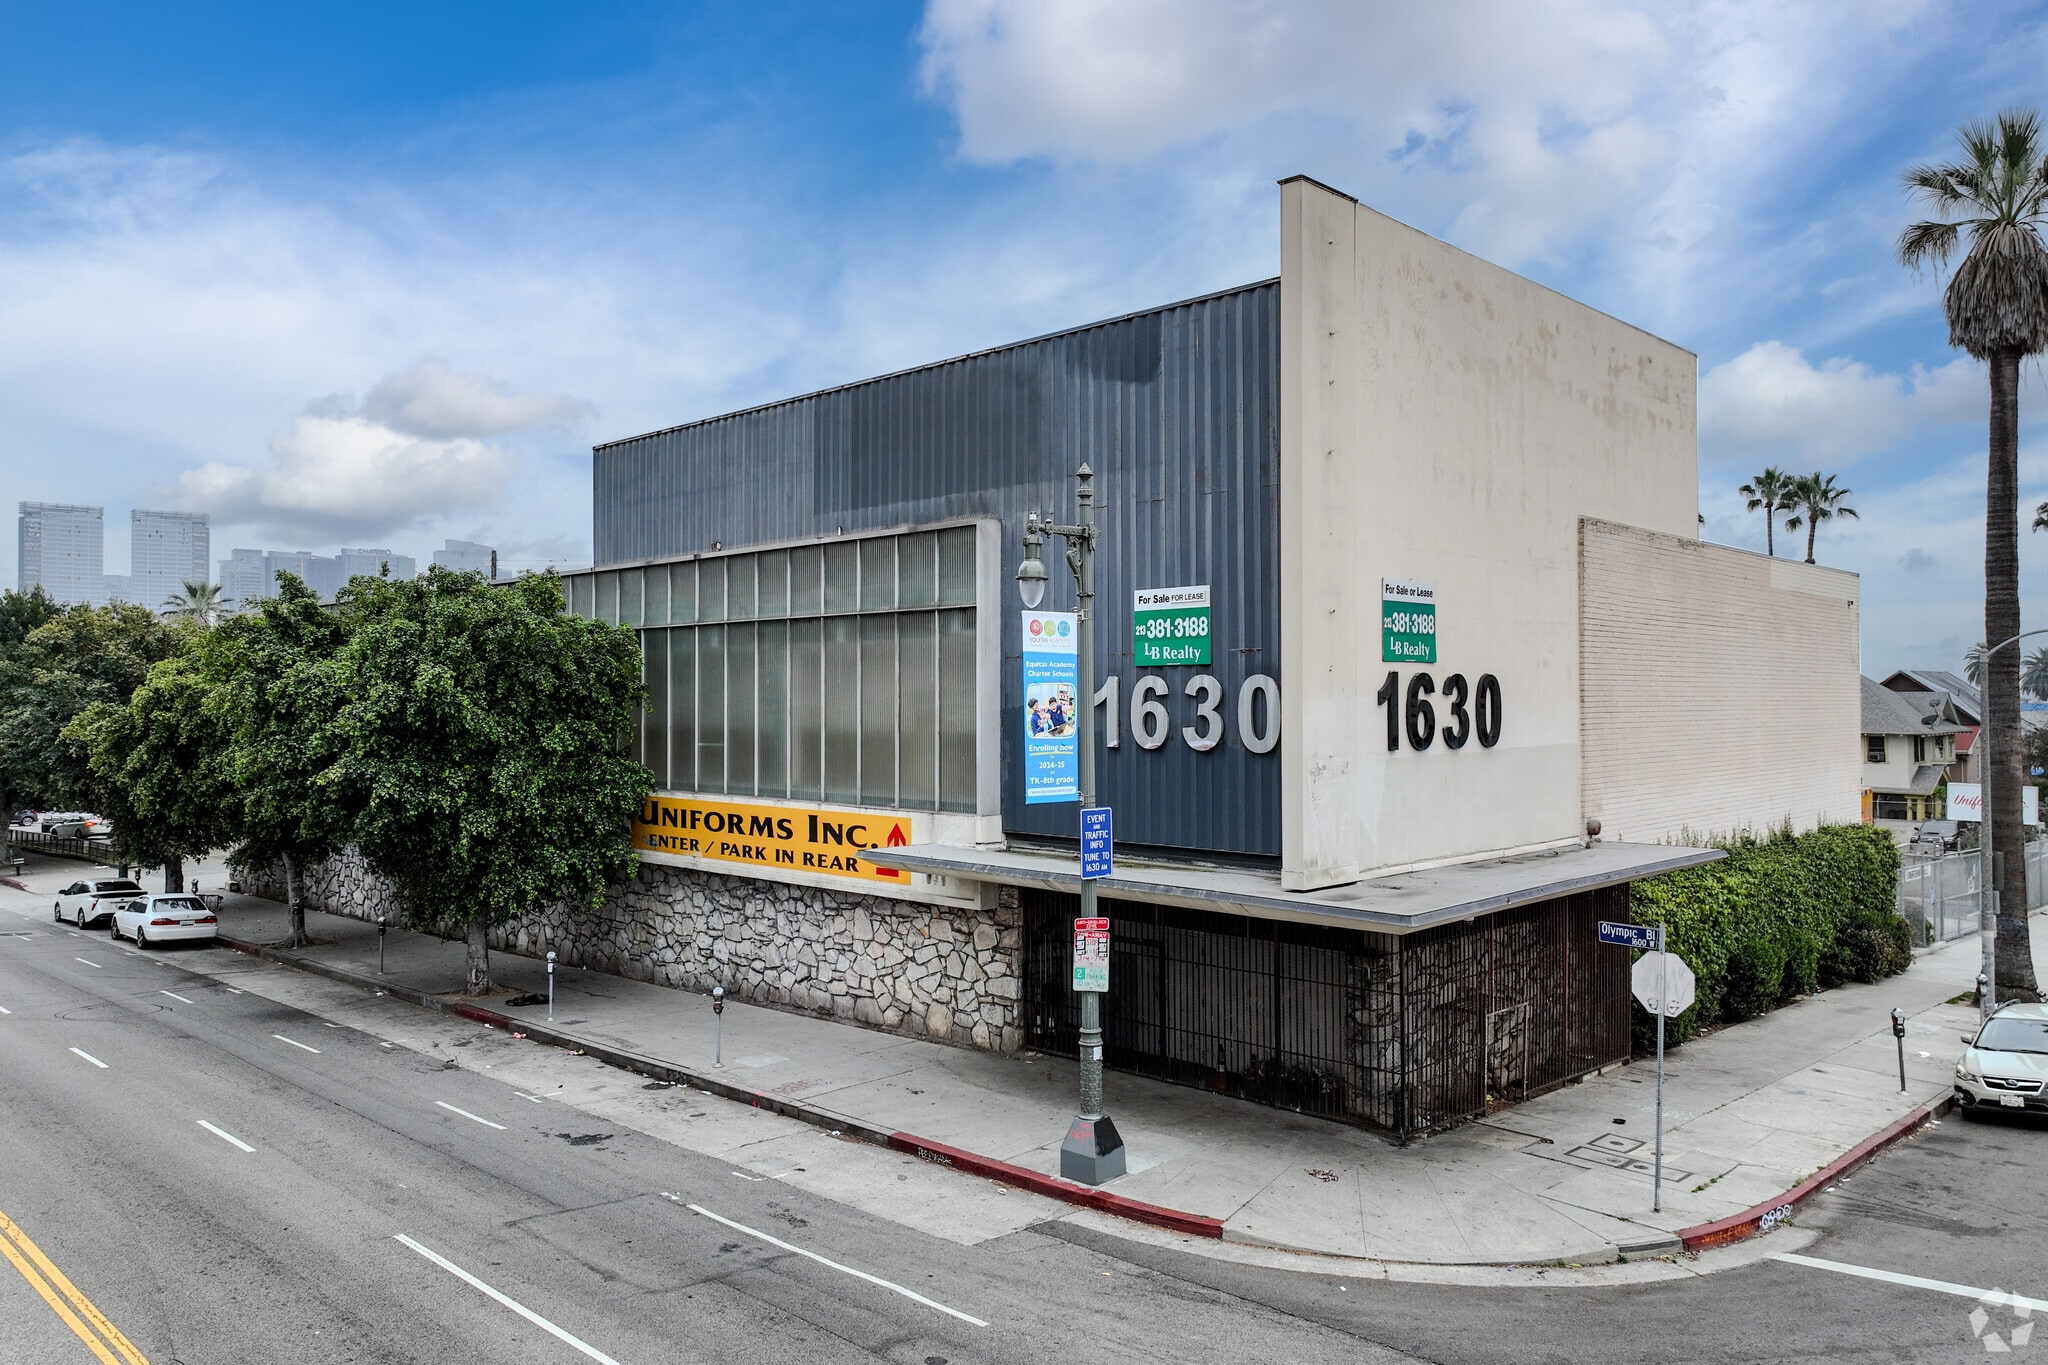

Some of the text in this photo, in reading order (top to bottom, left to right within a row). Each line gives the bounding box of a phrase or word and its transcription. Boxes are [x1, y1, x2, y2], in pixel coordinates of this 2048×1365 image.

[1385, 584, 1433, 598] For Sale or Lease
[1138, 595, 1151, 605] For
[1153, 594, 1170, 604] Sale
[1185, 593, 1203, 601] LEASE
[1135, 625, 1146, 635] 213
[1144, 643, 1201, 662] LB Realty
[1391, 636, 1430, 660] LB Realty
[1094, 674, 1281, 754] 1630
[1378, 671, 1501, 751] 1630
[1029, 744, 1058, 752] Enrolling
[1056, 776, 1074, 785] grade
[639, 800, 793, 840] UNIFORMS
[1087, 814, 1106, 823] EVENT
[1085, 830, 1108, 840] TRAFFIC
[1090, 840, 1103, 849] INFO
[648, 833, 700, 851] ENTER
[721, 842, 766, 861] PARK
[775, 849, 794, 864] IN
[803, 852, 859, 872] REAR
[1084, 851, 1110, 862] TUNE TO
[1086, 862, 1100, 872] 1630
[1601, 923, 1656, 941] Olympic Bl
[1632, 938, 1647, 947] 1600
[1077, 969, 1082, 978] 2
